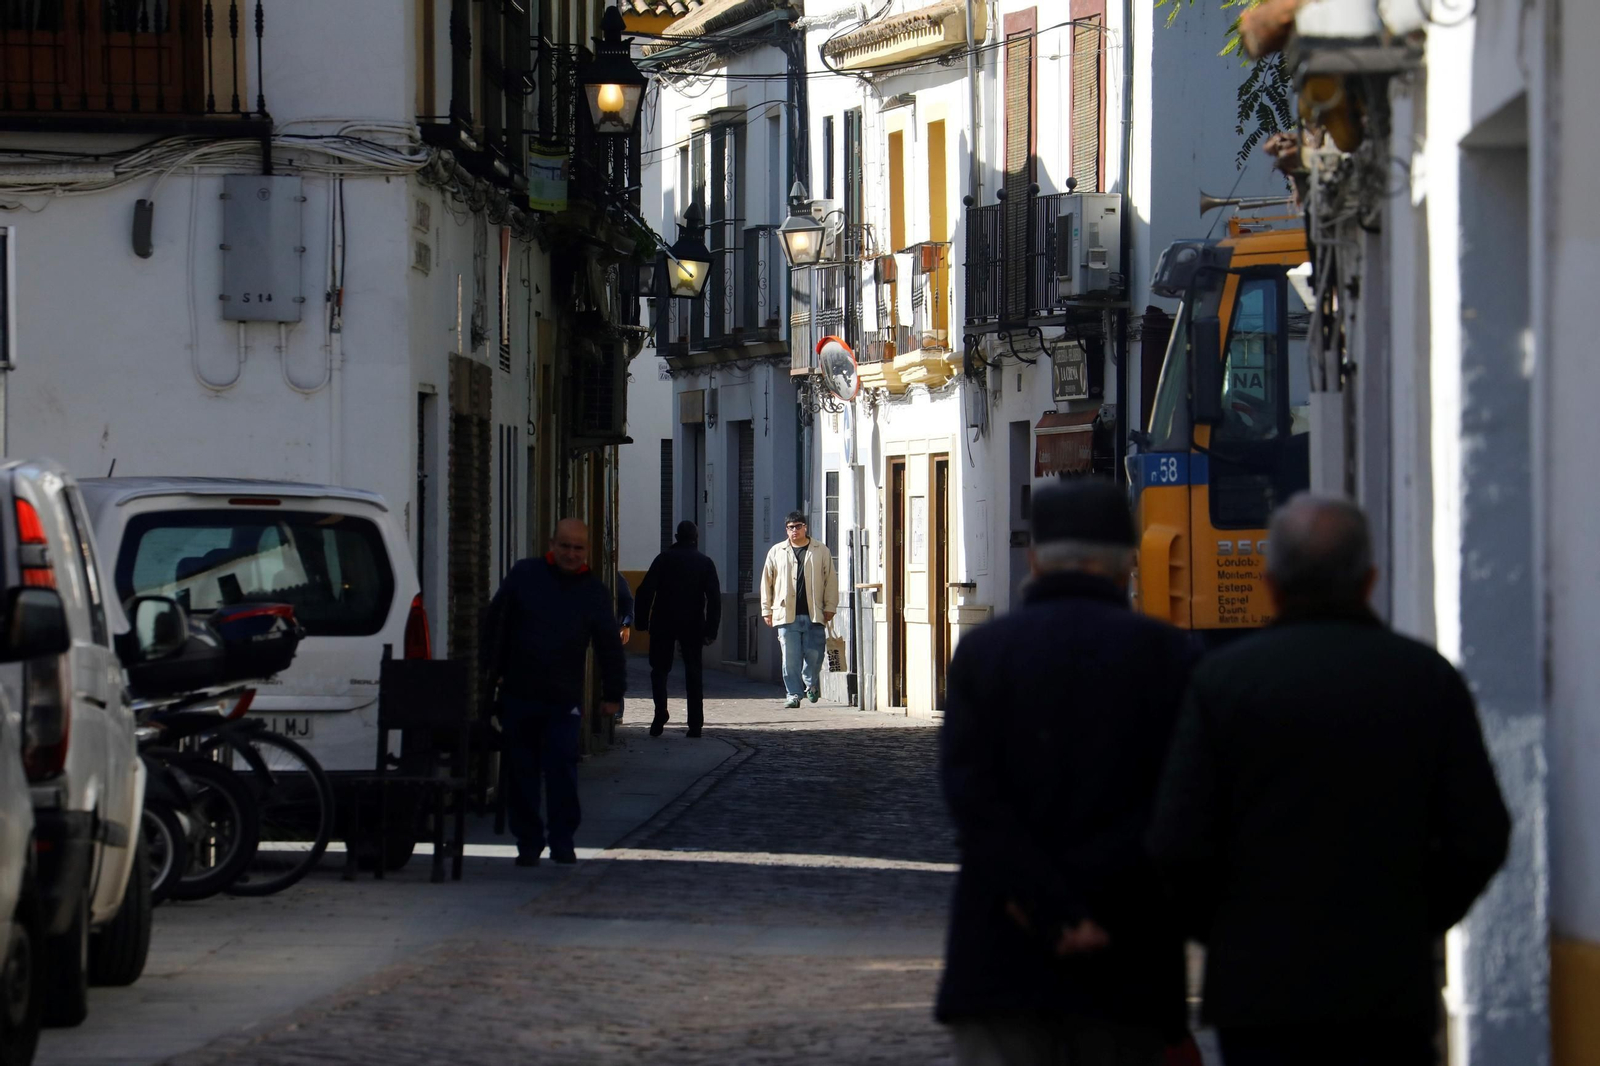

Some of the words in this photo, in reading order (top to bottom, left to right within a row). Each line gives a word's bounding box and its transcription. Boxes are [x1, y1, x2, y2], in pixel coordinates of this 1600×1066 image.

[242, 292, 250, 303] S
[258, 293, 273, 303] 14
[1233, 373, 1263, 389] NA
[1160, 457, 1178, 482] 58
